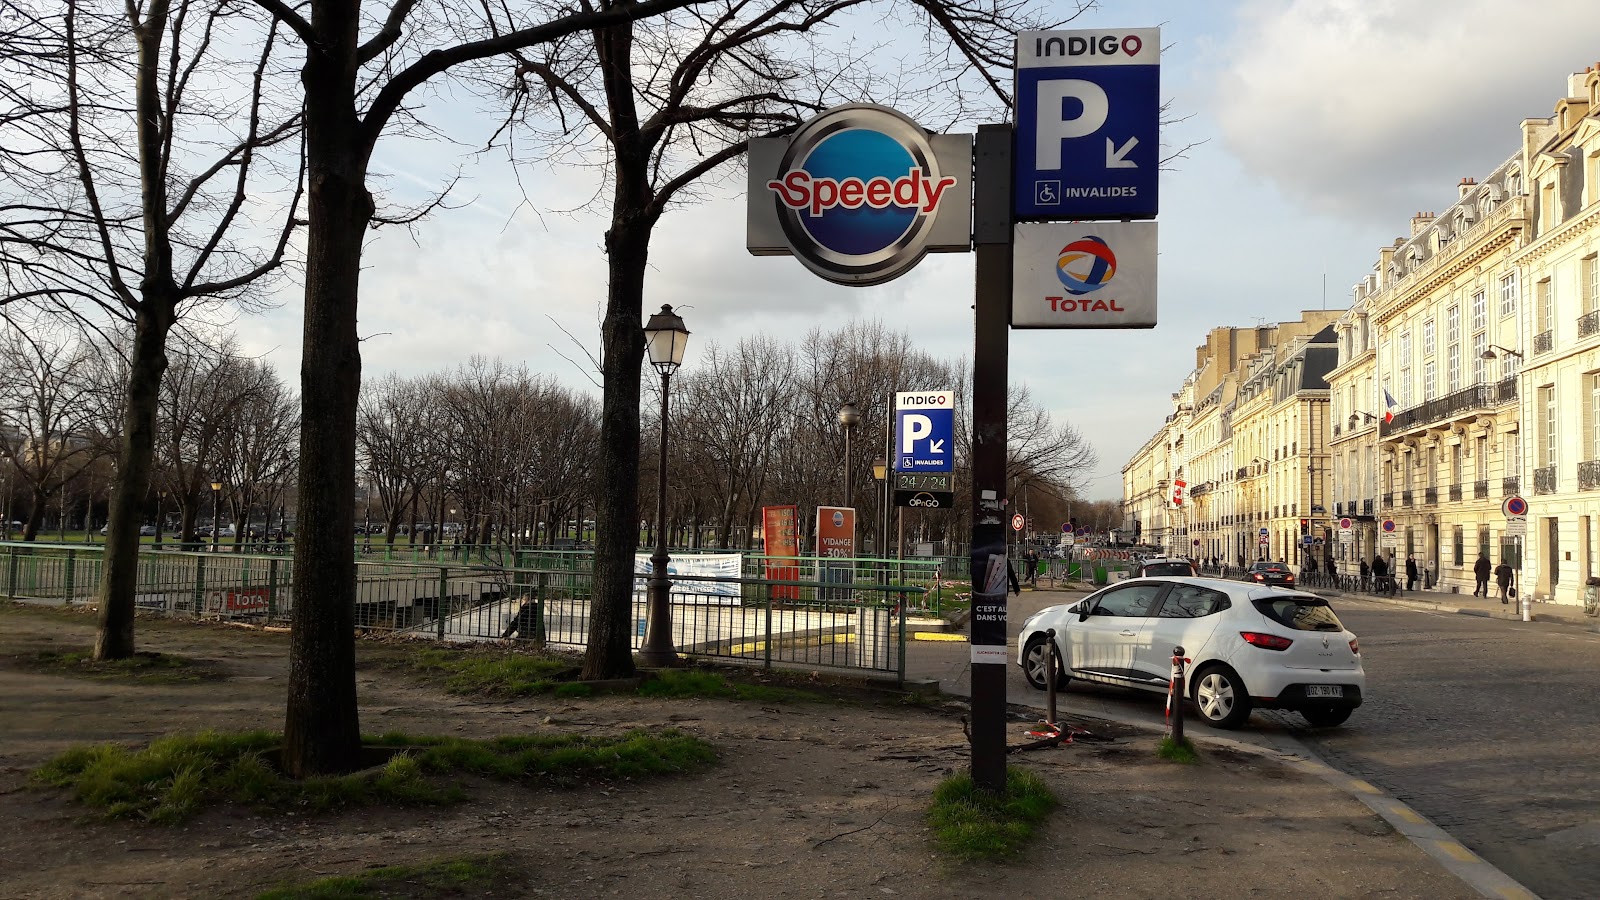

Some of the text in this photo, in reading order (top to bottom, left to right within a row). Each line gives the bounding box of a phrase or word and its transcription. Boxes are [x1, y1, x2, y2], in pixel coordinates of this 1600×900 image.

[1035, 35, 1143, 58] INDIGO
[1035, 79, 1109, 171] P
[768, 166, 956, 215] Speedy
[1065, 186, 1138, 198] INVALIDES
[1045, 296, 1125, 312] TOTAL
[903, 395, 946, 405] INDIGO
[902, 414, 932, 453] P
[822, 537, 851, 546] VIDANGE
[976, 605, 997, 613] C'EST
